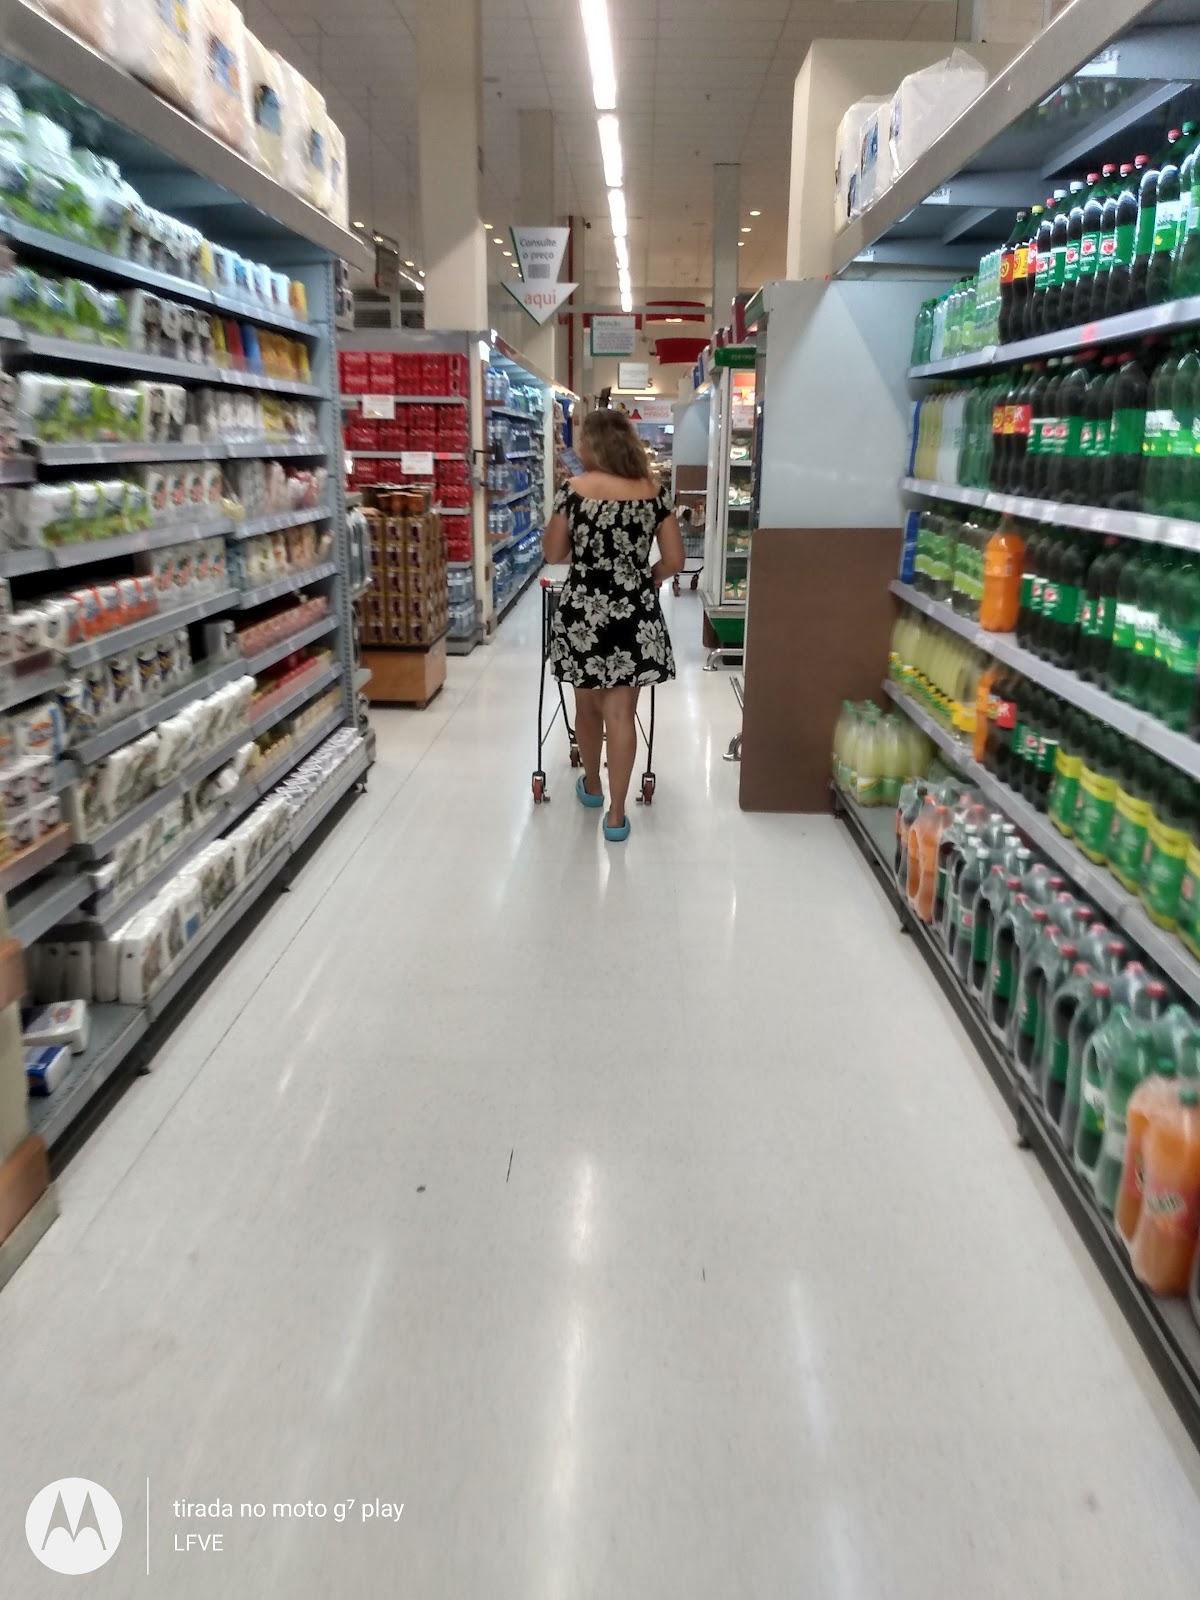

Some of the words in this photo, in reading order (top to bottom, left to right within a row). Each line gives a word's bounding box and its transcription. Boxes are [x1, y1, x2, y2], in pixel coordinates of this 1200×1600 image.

[519, 237, 557, 247] Consulte
[522, 252, 529, 260] o
[530, 251, 554, 261] preço
[523, 288, 557, 309] aqui
